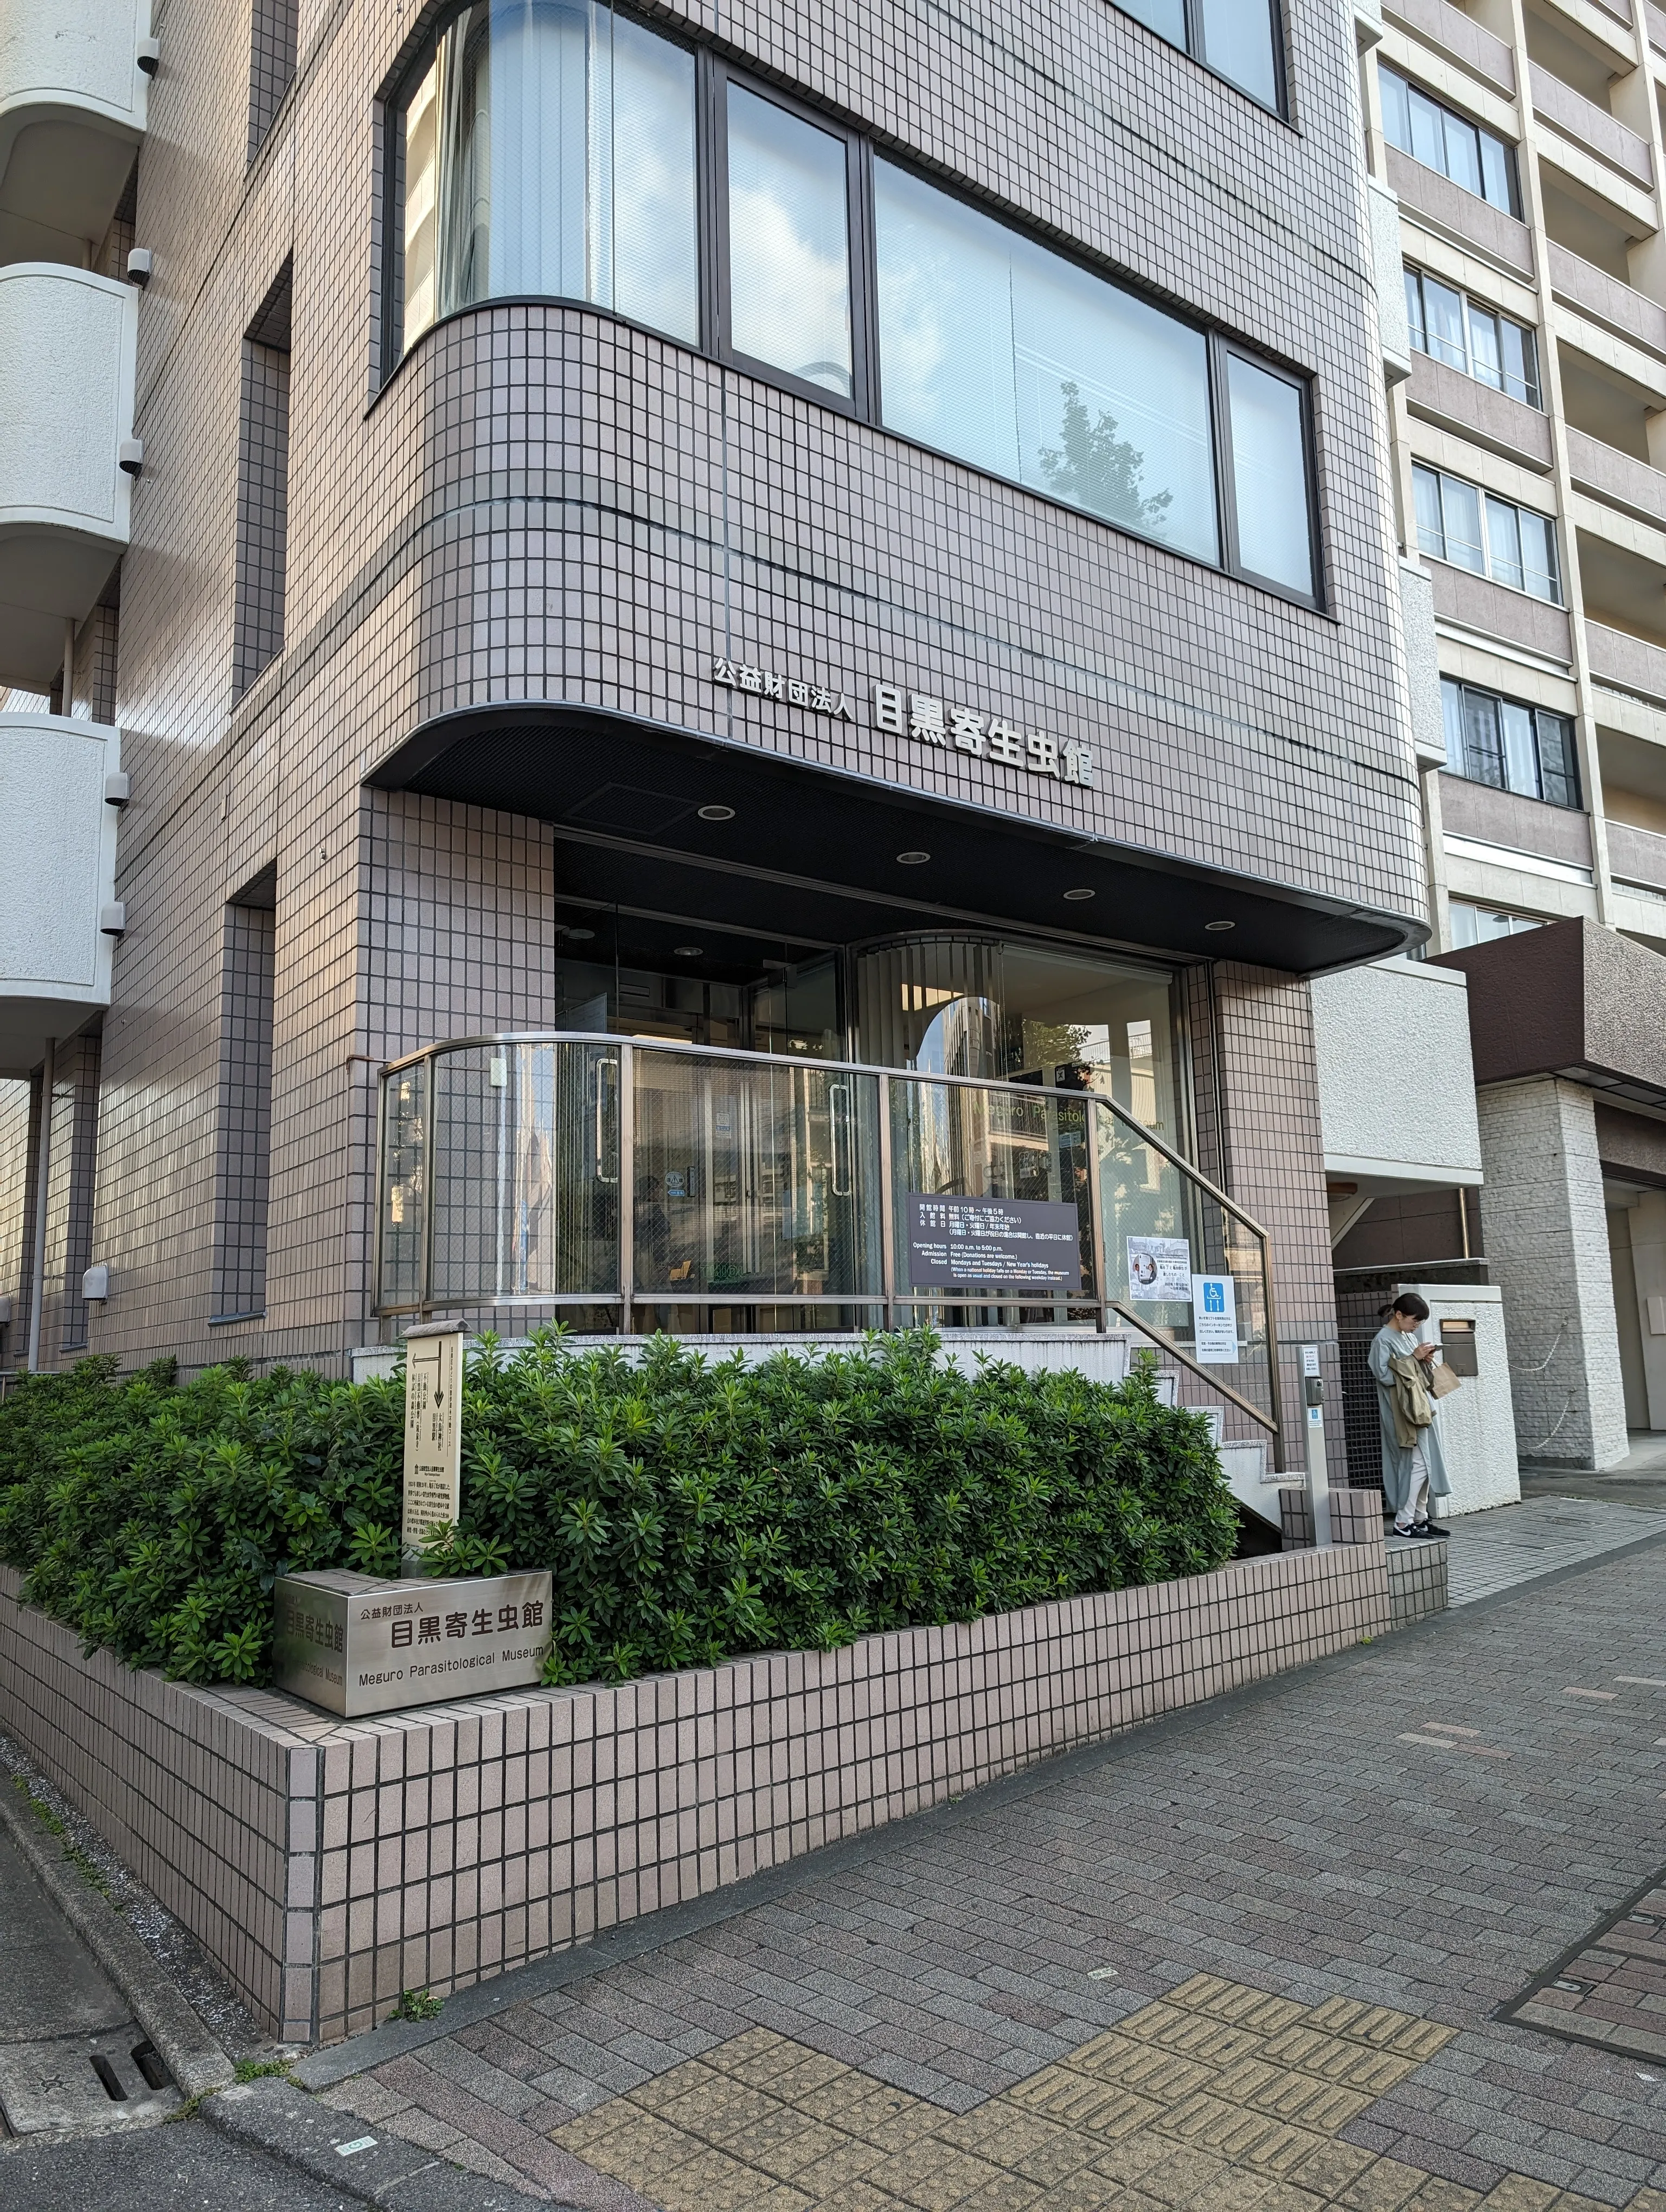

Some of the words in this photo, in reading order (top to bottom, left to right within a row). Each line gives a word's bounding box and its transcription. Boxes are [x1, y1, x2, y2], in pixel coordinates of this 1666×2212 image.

[713, 657, 854, 721] 公益財団法人
[873, 684, 1094, 788] 目黒寄生虫館
[919, 1204, 945, 1212] 開館時間
[286, 1609, 343, 1653] 目黒寄生虫館
[360, 1602, 424, 1621] 公益財団法人
[391, 1599, 543, 1649] 目黒寄生虫館
[325, 1667, 343, 1686] Museum
[359, 1670, 403, 1687] Meguro
[409, 1652, 495, 1678] Parasitological
[502, 1645, 543, 1662] Museum
